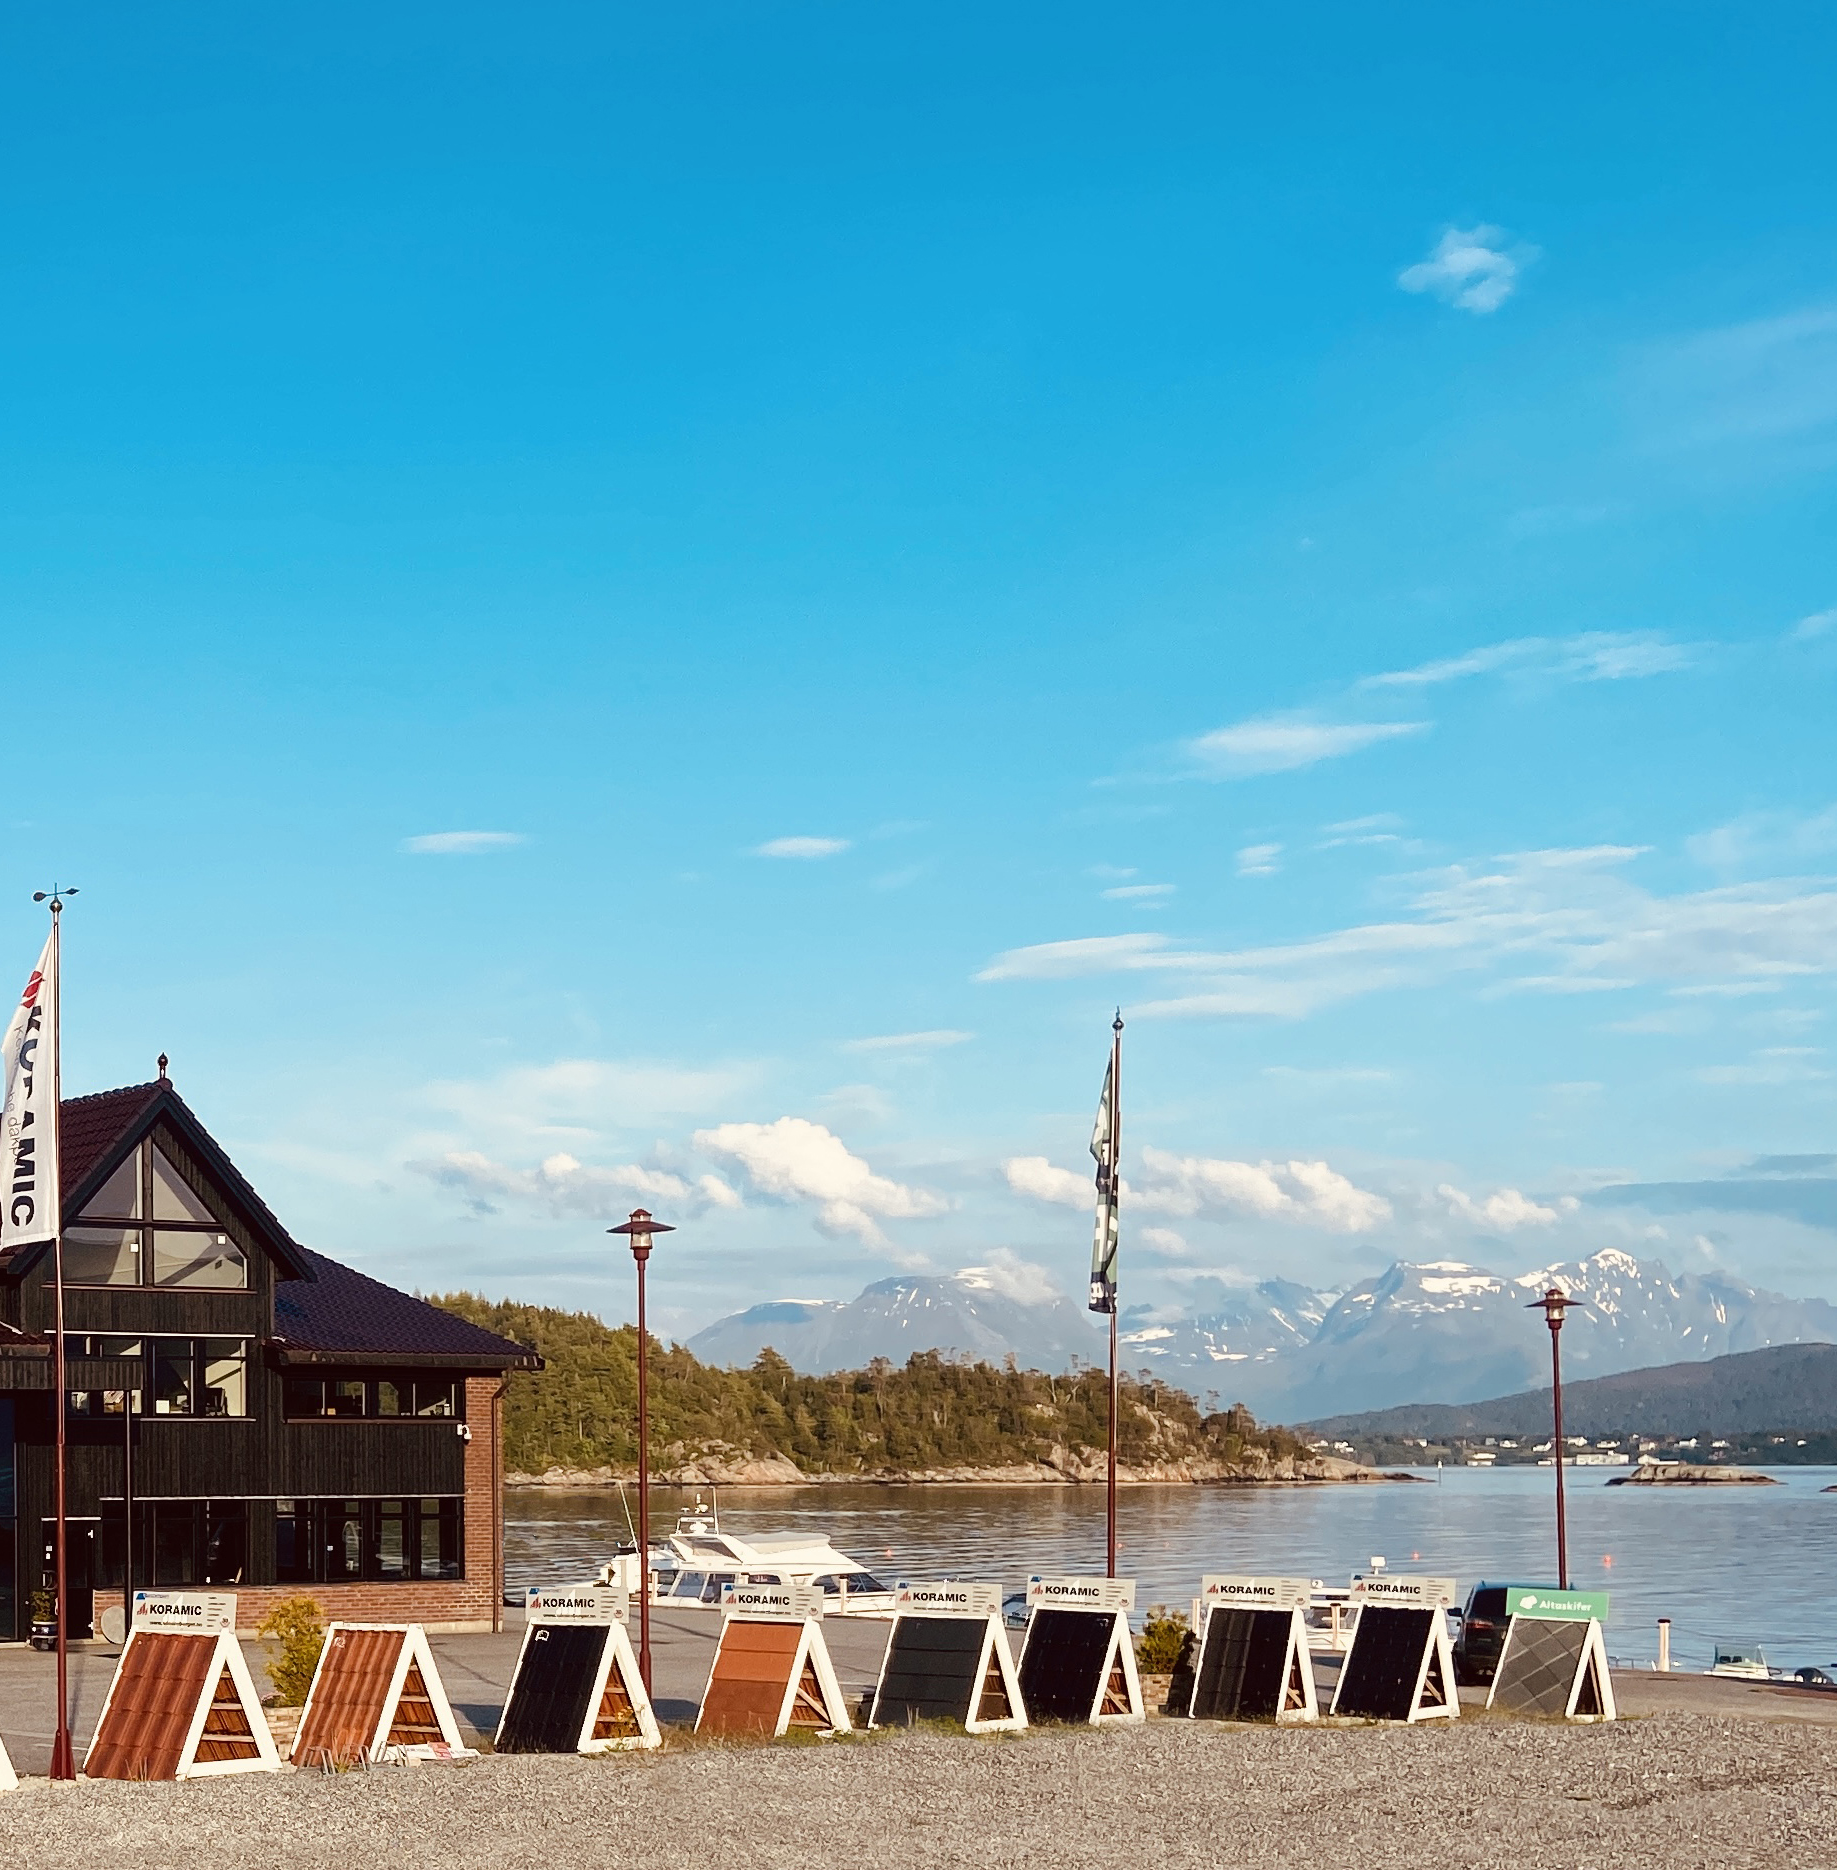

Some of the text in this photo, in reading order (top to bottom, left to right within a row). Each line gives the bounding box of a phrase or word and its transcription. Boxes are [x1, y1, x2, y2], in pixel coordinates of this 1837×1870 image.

[1045, 1585, 1100, 1597] KORAMIC
[1220, 1585, 1275, 1596] KORAMIC
[1368, 1583, 1421, 1594] KORAMIC
[738, 1594, 790, 1606] KORAMIC
[913, 1592, 967, 1602] KORAMIC
[543, 1598, 595, 1608] KORAMIC
[1539, 1600, 1592, 1612] Altaskifer
[150, 1604, 202, 1616] KORAMIC
